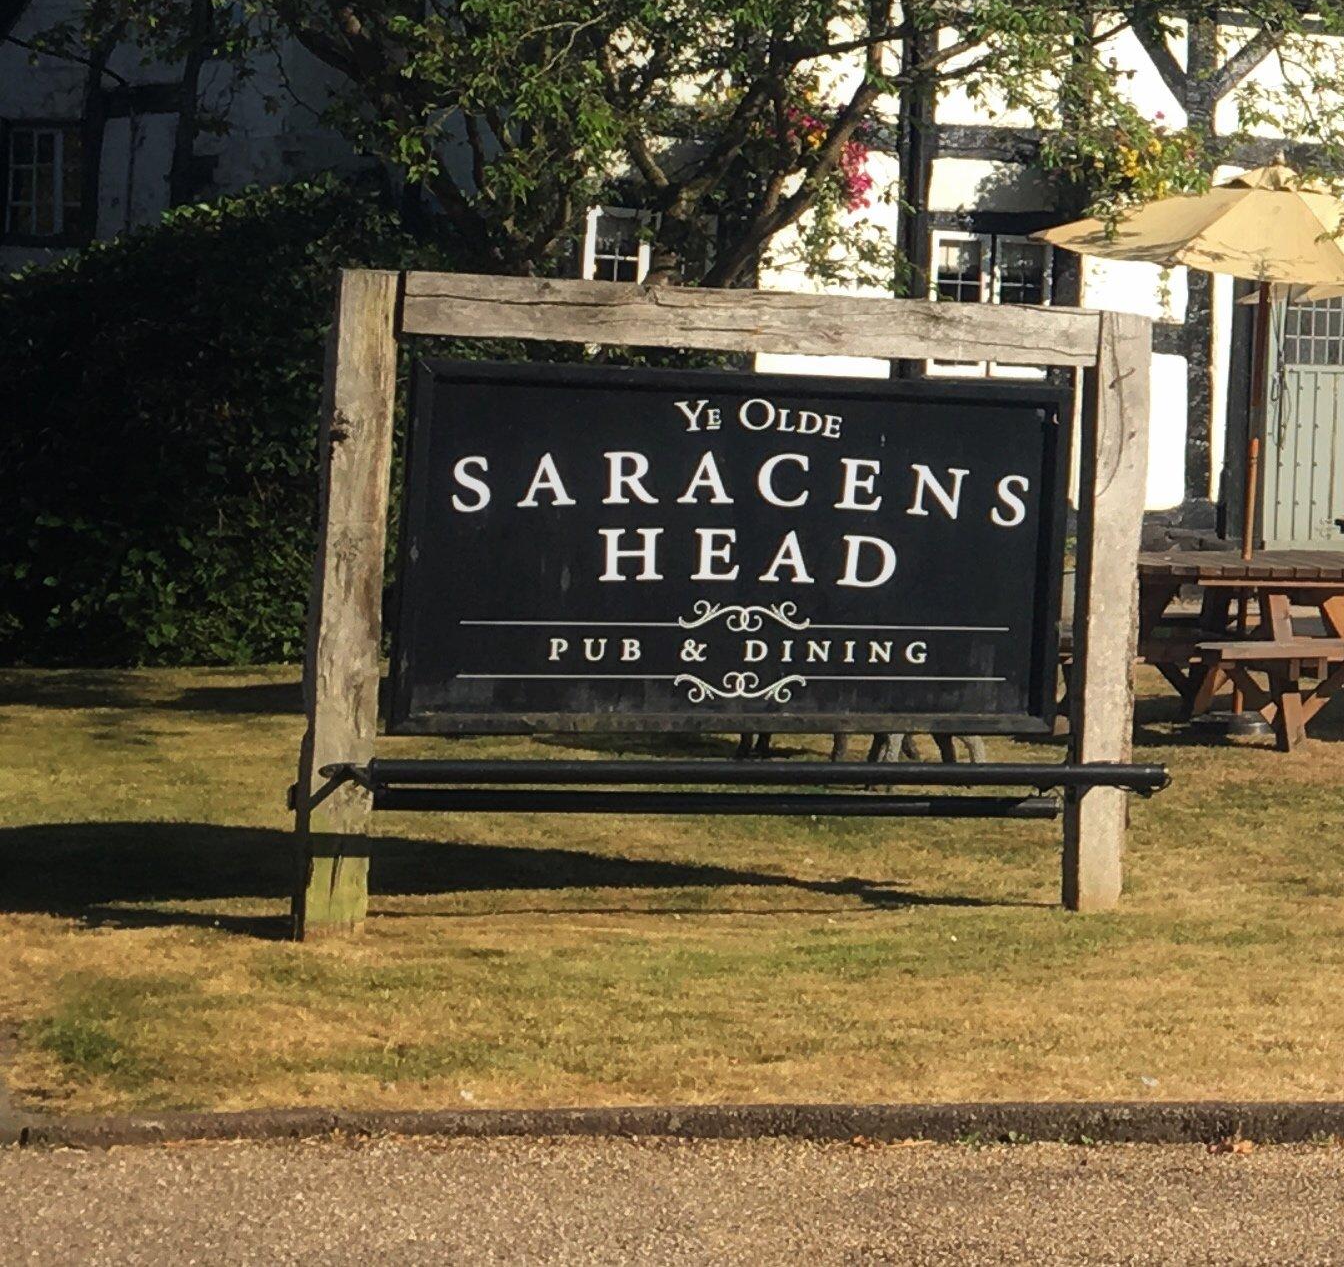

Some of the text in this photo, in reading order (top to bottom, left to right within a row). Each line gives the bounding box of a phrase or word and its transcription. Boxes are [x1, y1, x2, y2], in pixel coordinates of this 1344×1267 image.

[674, 398, 843, 438] YE OLDE
[451, 450, 1030, 528] SARACENS
[598, 527, 898, 588] HEAD
[548, 638, 929, 664] PUB & DINING
